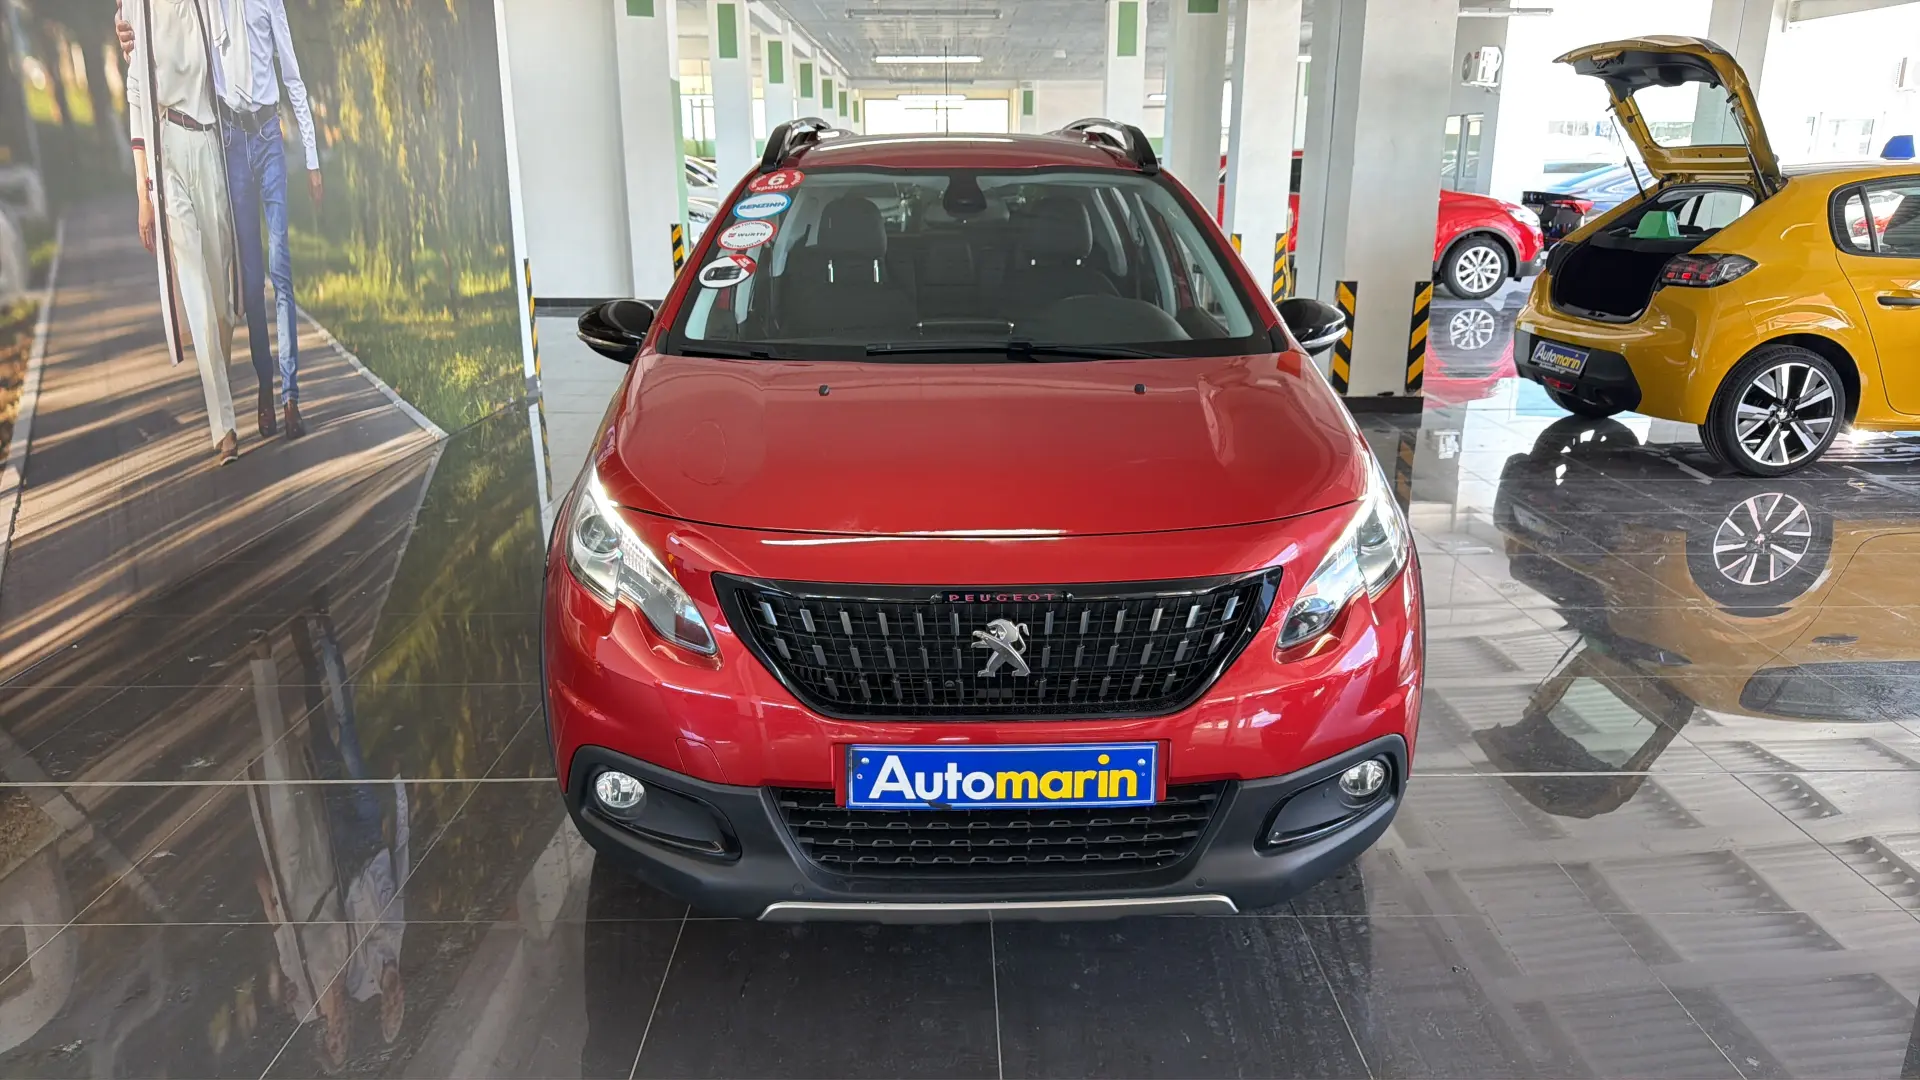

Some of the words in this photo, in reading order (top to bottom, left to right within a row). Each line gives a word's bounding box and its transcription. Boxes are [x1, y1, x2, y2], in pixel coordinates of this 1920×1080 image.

[768, 173, 787, 186] 6
[1535, 344, 1581, 370] Automarin
[948, 593, 1056, 603] PEUGEOT
[868, 753, 1138, 800] Automarin
